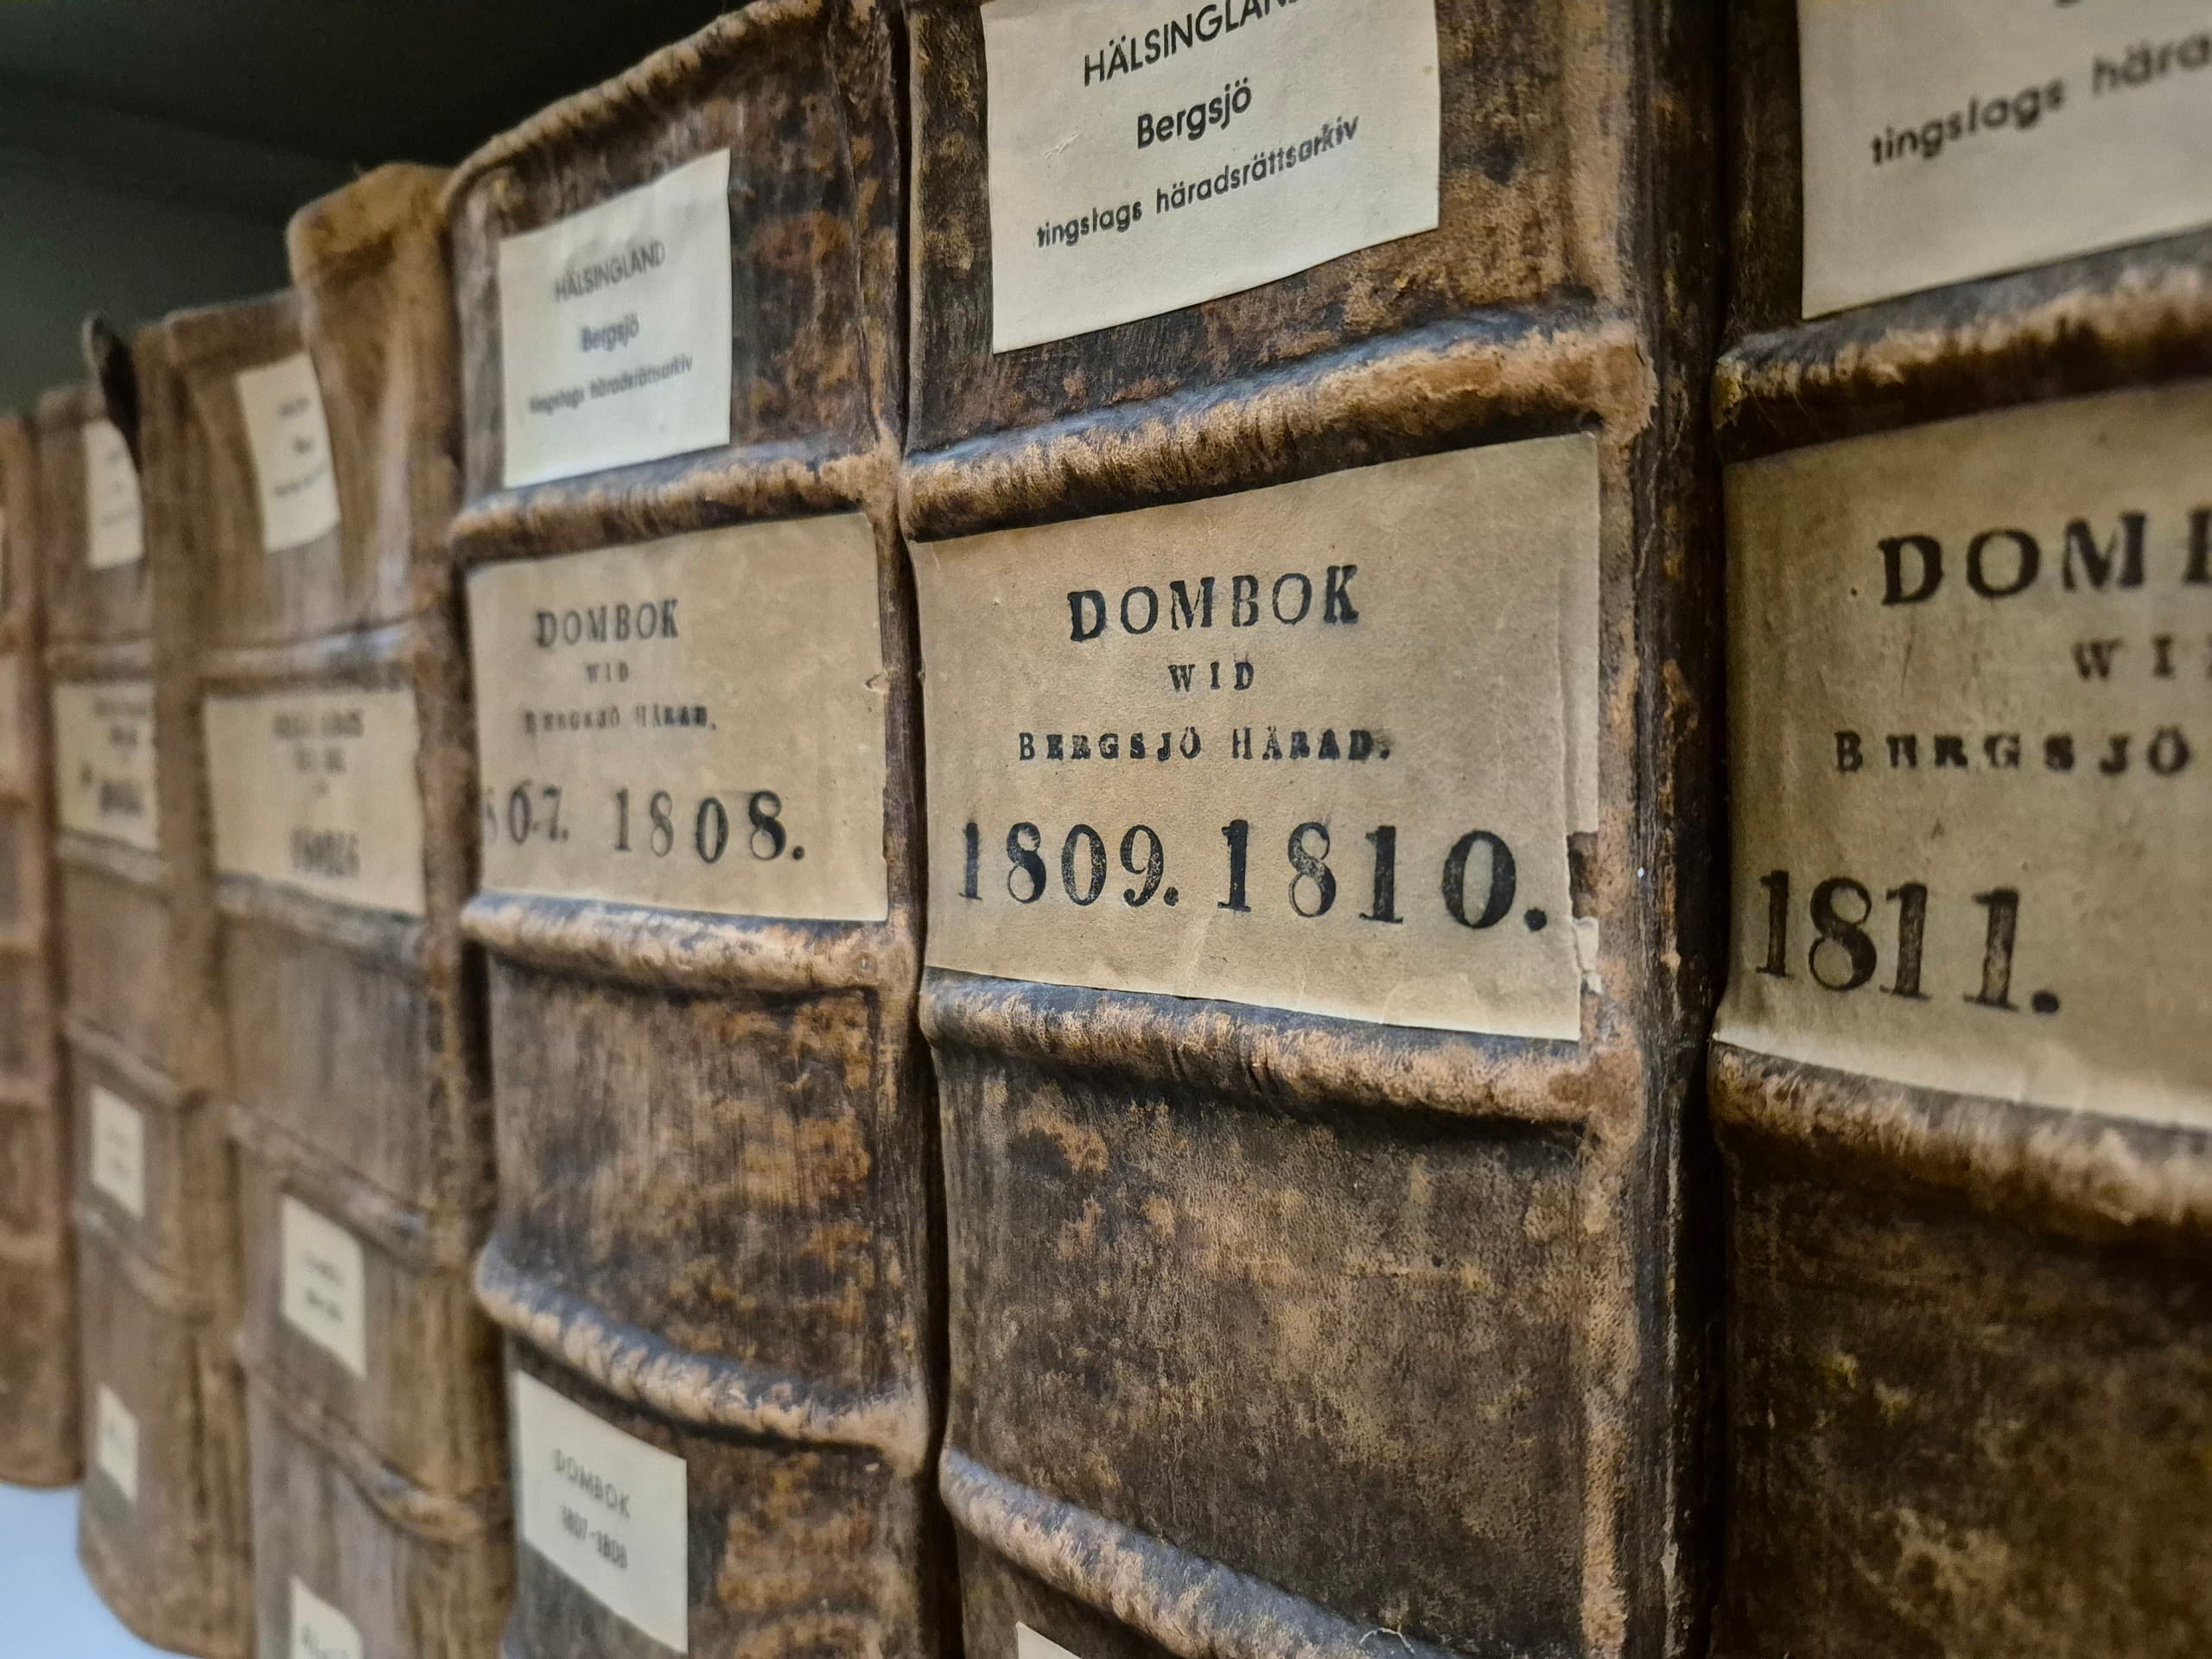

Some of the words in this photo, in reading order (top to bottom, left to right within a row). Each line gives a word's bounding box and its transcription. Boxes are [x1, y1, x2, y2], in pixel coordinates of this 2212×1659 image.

[1084, 0, 1297, 86] HÄLSINGLA
[1136, 77, 1252, 149] Bergsjö
[1870, 79, 2066, 166] tingslags
[1037, 199, 1141, 248] tingslags
[1156, 116, 1358, 214] häradsrättsarkiv
[554, 240, 665, 302] HÄLSINGLAND
[581, 312, 639, 351] Bergsjö
[537, 598, 679, 648] DOMBOK
[1067, 564, 1359, 642] DOMBOK
[1168, 661, 1255, 691] WID
[2073, 633, 2212, 679] WI
[1018, 726, 1202, 761] BERGSJÖ
[613, 787, 805, 864] 1808.
[958, 820, 1179, 907] 1809.
[1217, 818, 1548, 931] 1810.
[1755, 870, 2060, 1015] 1811.
